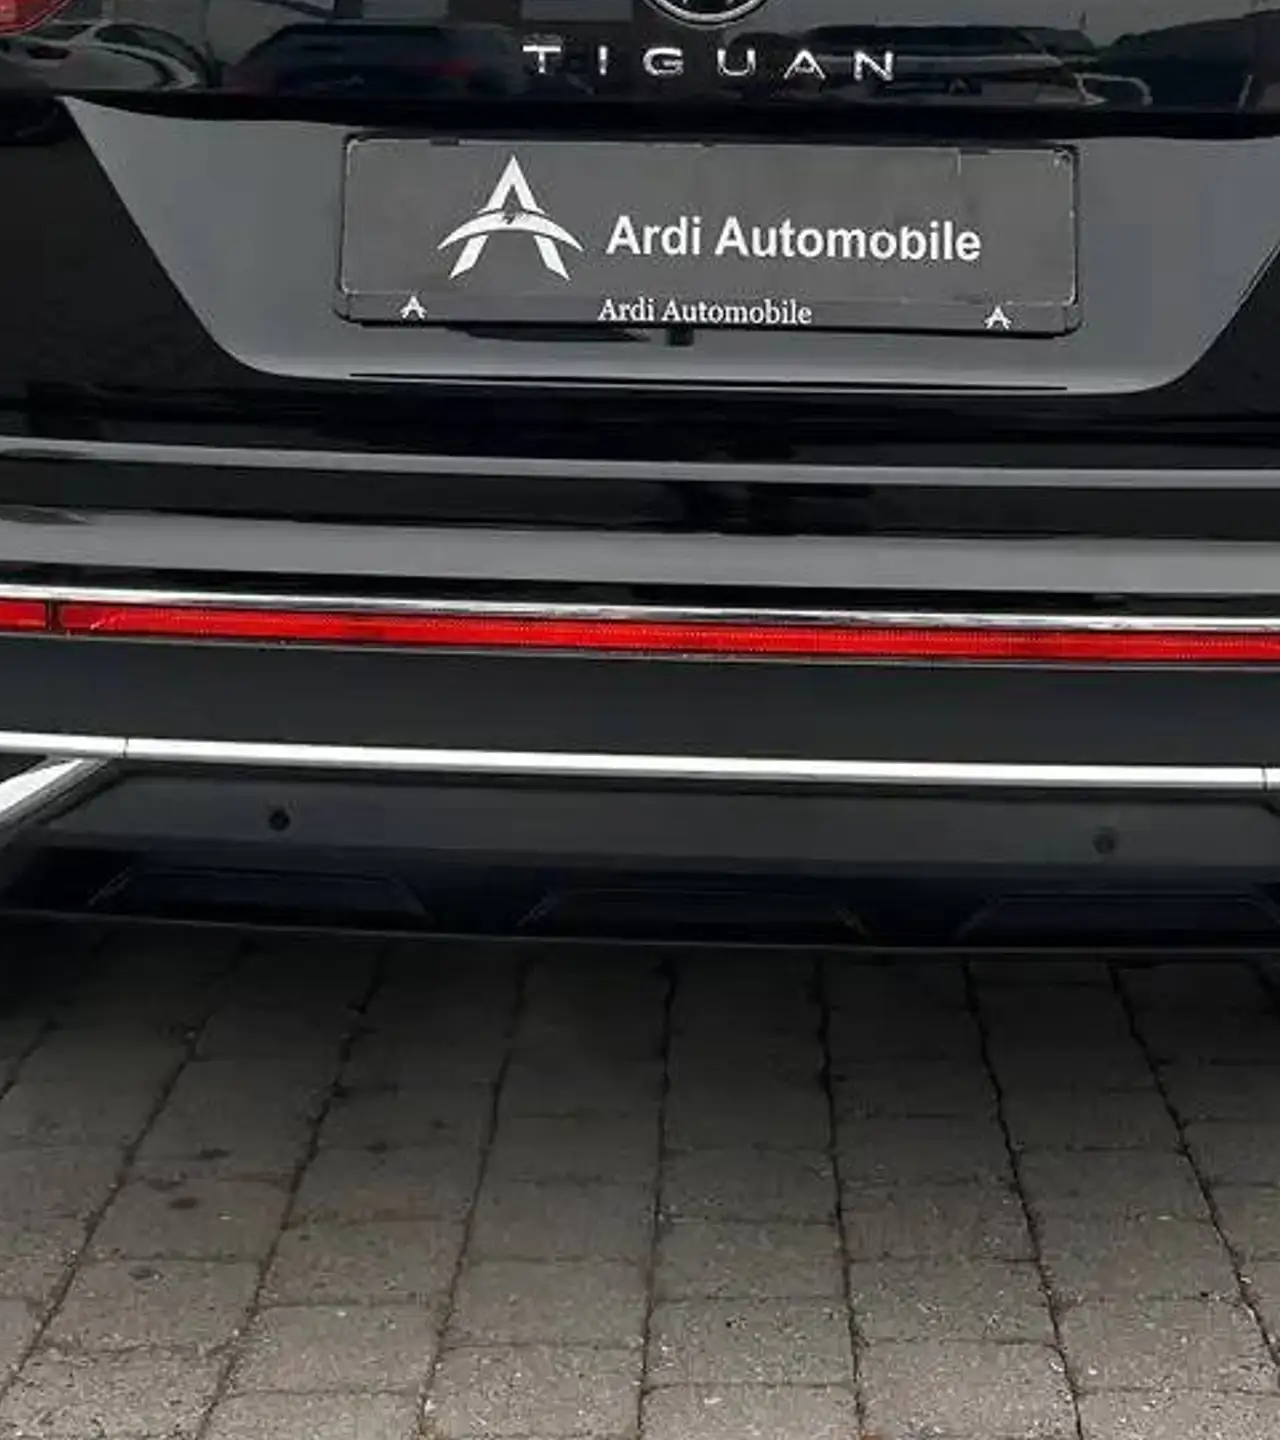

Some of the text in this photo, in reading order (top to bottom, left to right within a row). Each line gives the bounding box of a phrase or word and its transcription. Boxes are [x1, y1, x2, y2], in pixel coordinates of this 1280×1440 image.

[522, 44, 895, 82] TIGUAN
[605, 215, 982, 261] Ardi Automobile
[596, 297, 813, 326] Ardi Automobile
